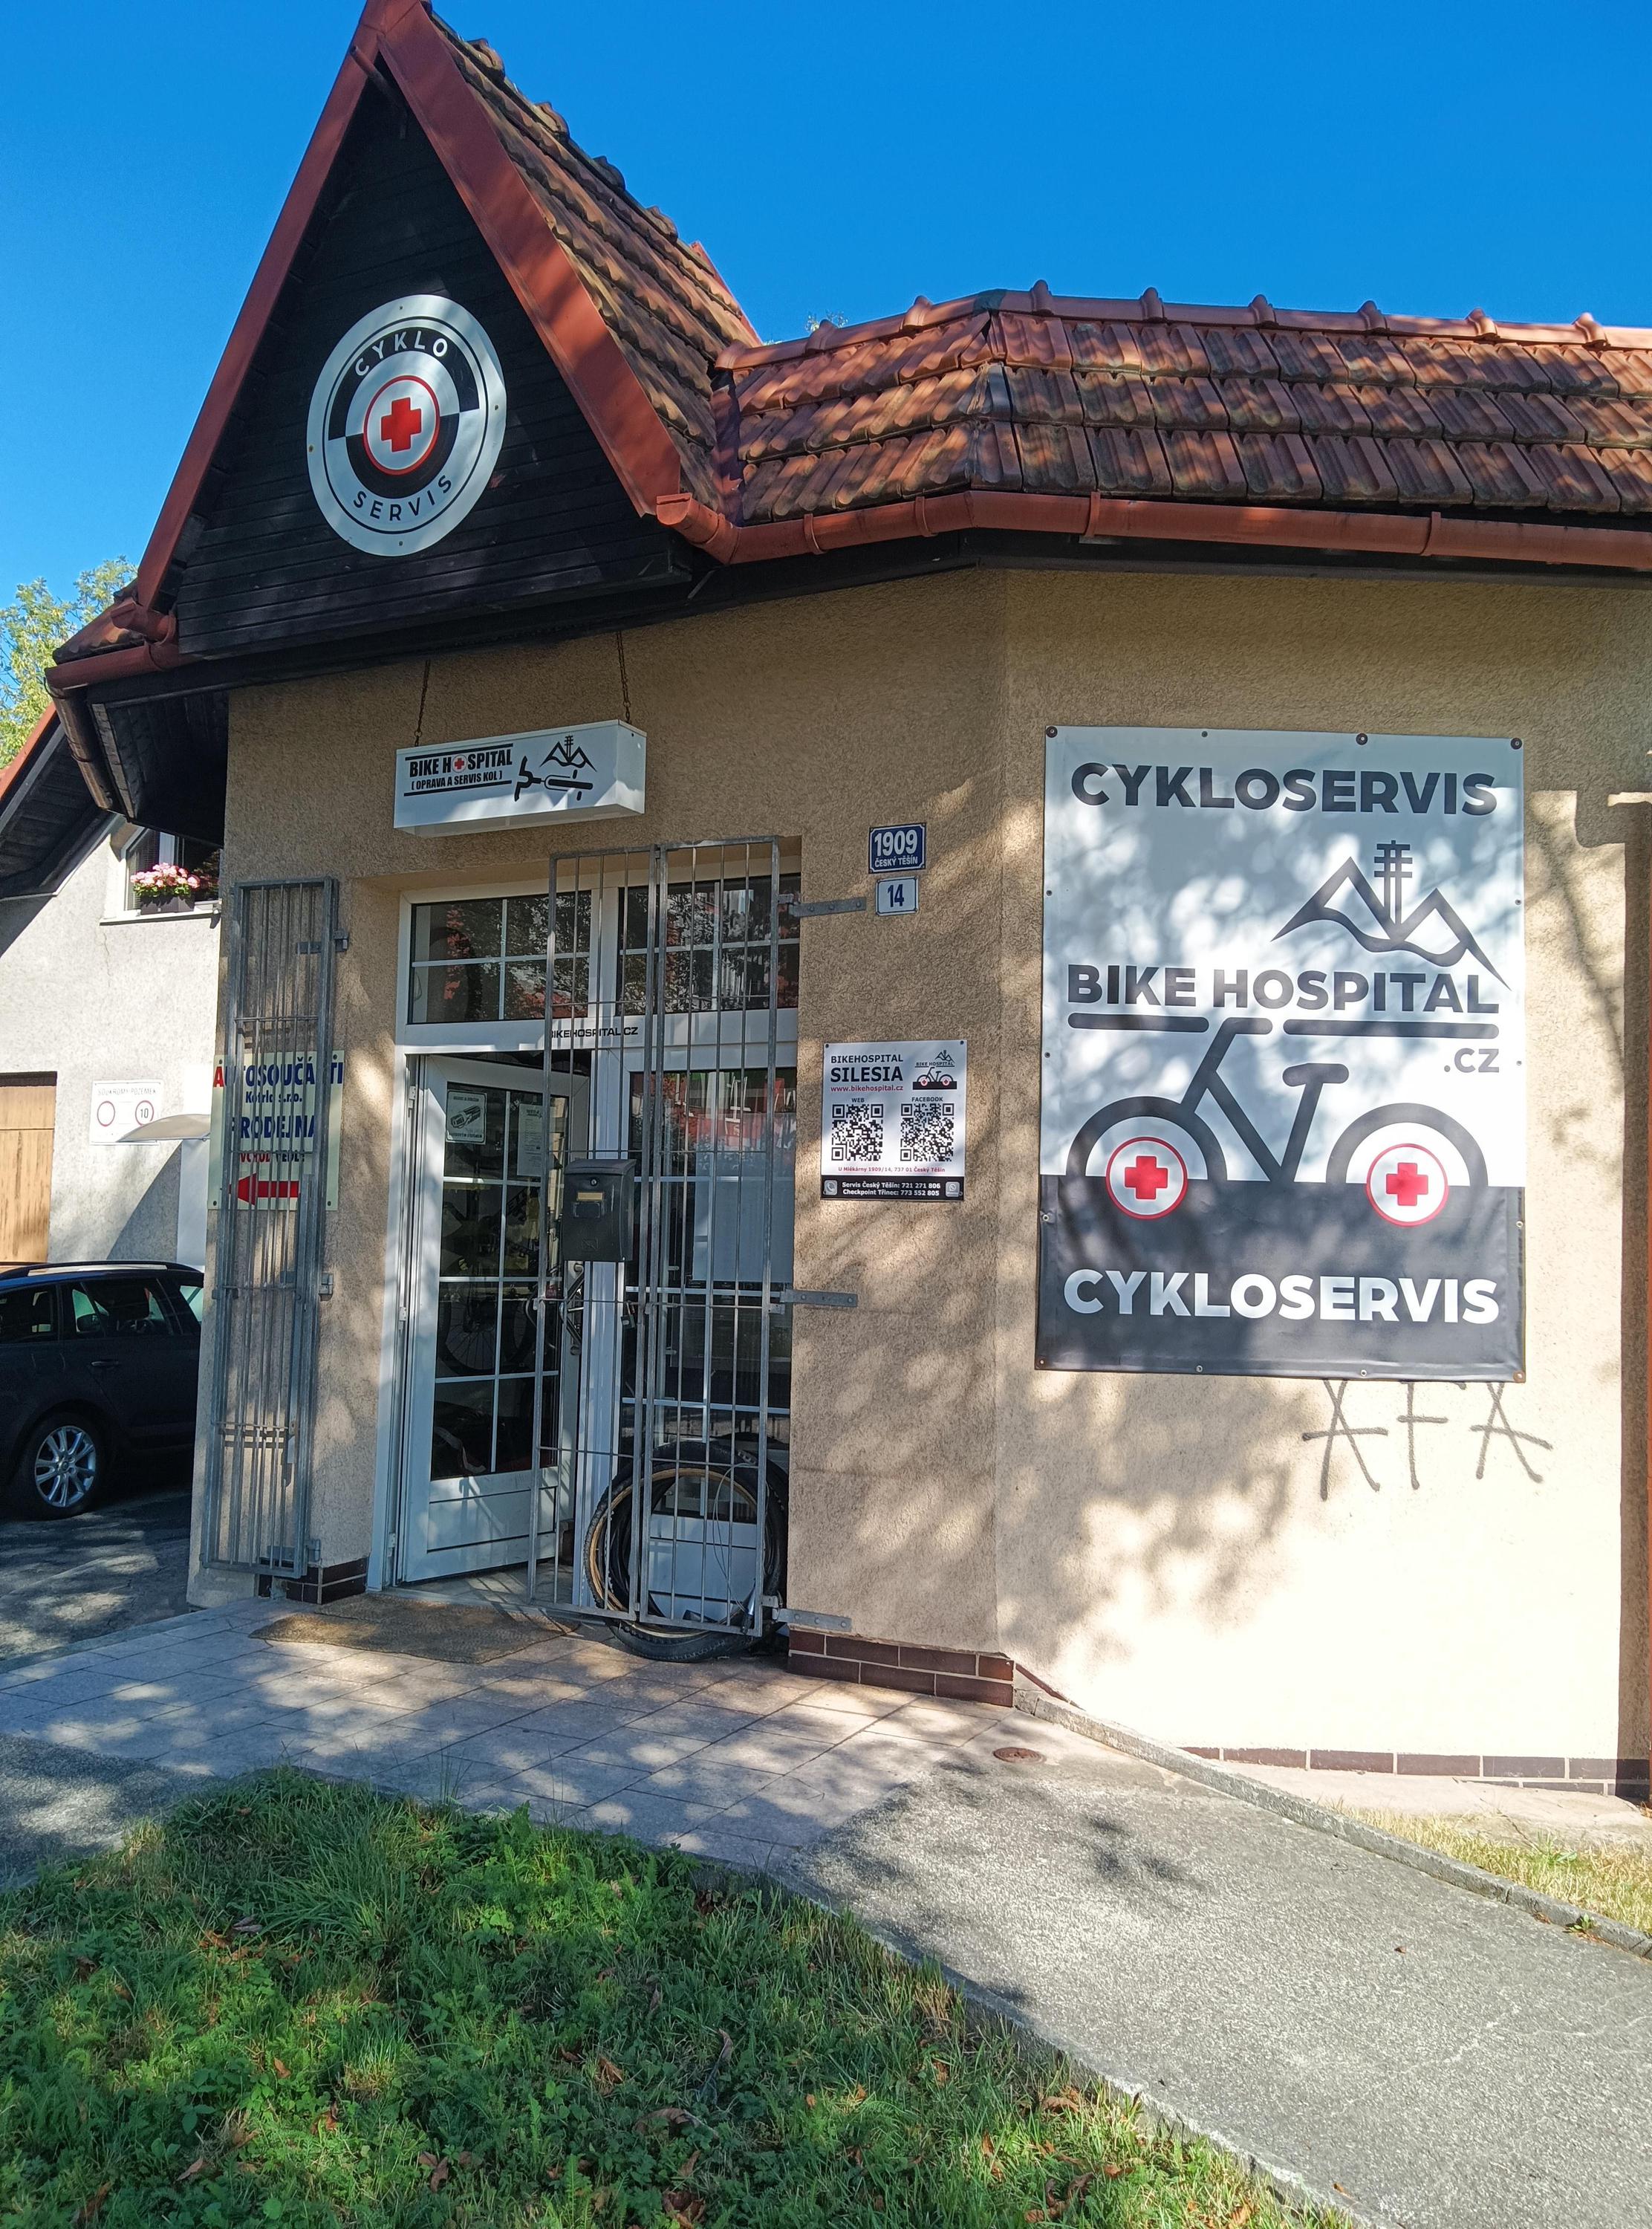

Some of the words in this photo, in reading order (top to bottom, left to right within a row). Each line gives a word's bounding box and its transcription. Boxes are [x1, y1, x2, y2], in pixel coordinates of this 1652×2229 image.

[354, 330, 448, 377] CYKLO
[353, 475, 452, 521] SERVIS
[409, 757, 439, 777] BIKE
[416, 778, 446, 790] OPRAVA
[447, 778, 453, 786] A
[455, 775, 483, 785] SERVIS
[483, 773, 498, 782] KOL
[1070, 762, 1498, 814] CYKLOSERVIS
[874, 829, 918, 857] 1909
[874, 856, 897, 868] ČESKÝ
[897, 854, 918, 866] TĚŠÍN
[887, 883, 905, 908] 14
[1067, 964, 1197, 1006] BIKE
[1212, 969, 1499, 1013] HOSPITAL
[830, 1054, 903, 1063] BIKEHOSPITAL
[1444, 1048, 1500, 1074] .CZ
[830, 1066, 903, 1083] SILESIA
[862, 1180, 879, 1189] Český
[1064, 1269, 1499, 1324] CYKLOSERVIS
